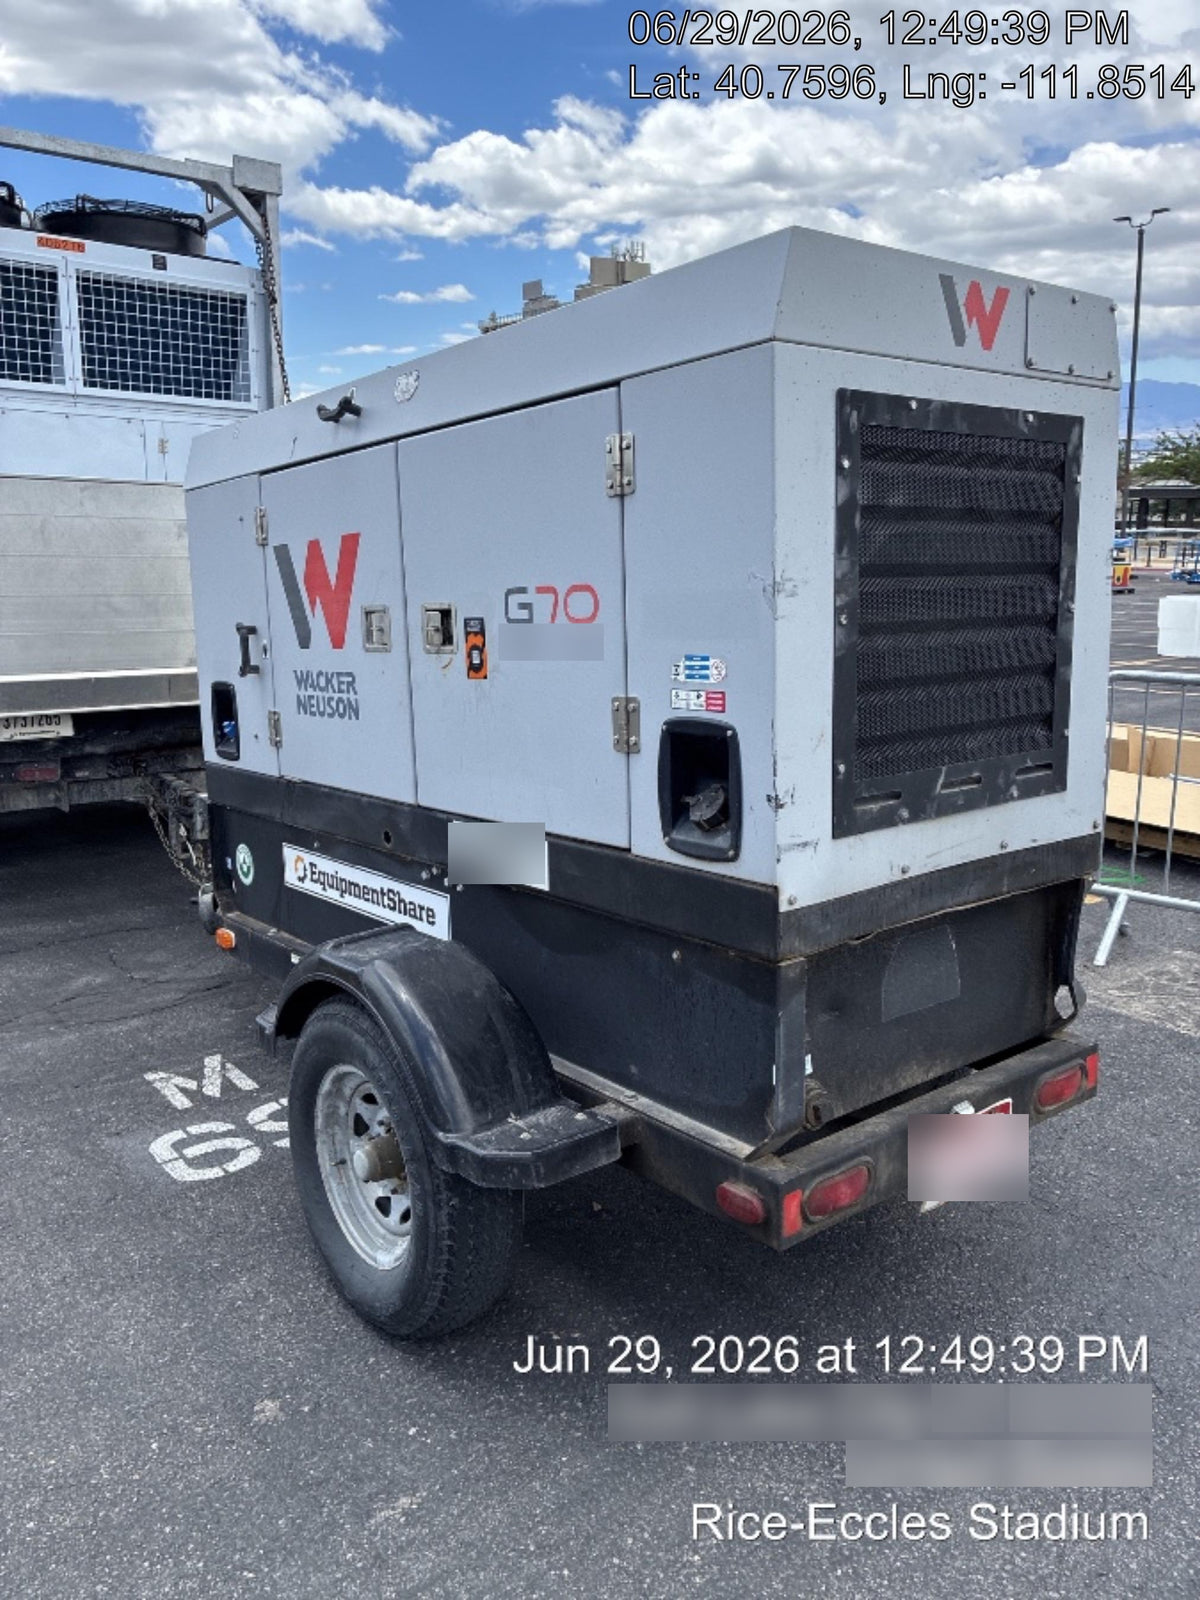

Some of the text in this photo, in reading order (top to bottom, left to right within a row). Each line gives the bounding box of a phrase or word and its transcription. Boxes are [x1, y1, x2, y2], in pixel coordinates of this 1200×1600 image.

[504, 584, 600, 624] G70
[293, 670, 358, 695] WACKER
[296, 695, 360, 720] NEUSON
[309, 861, 436, 927] EquipmentShare
